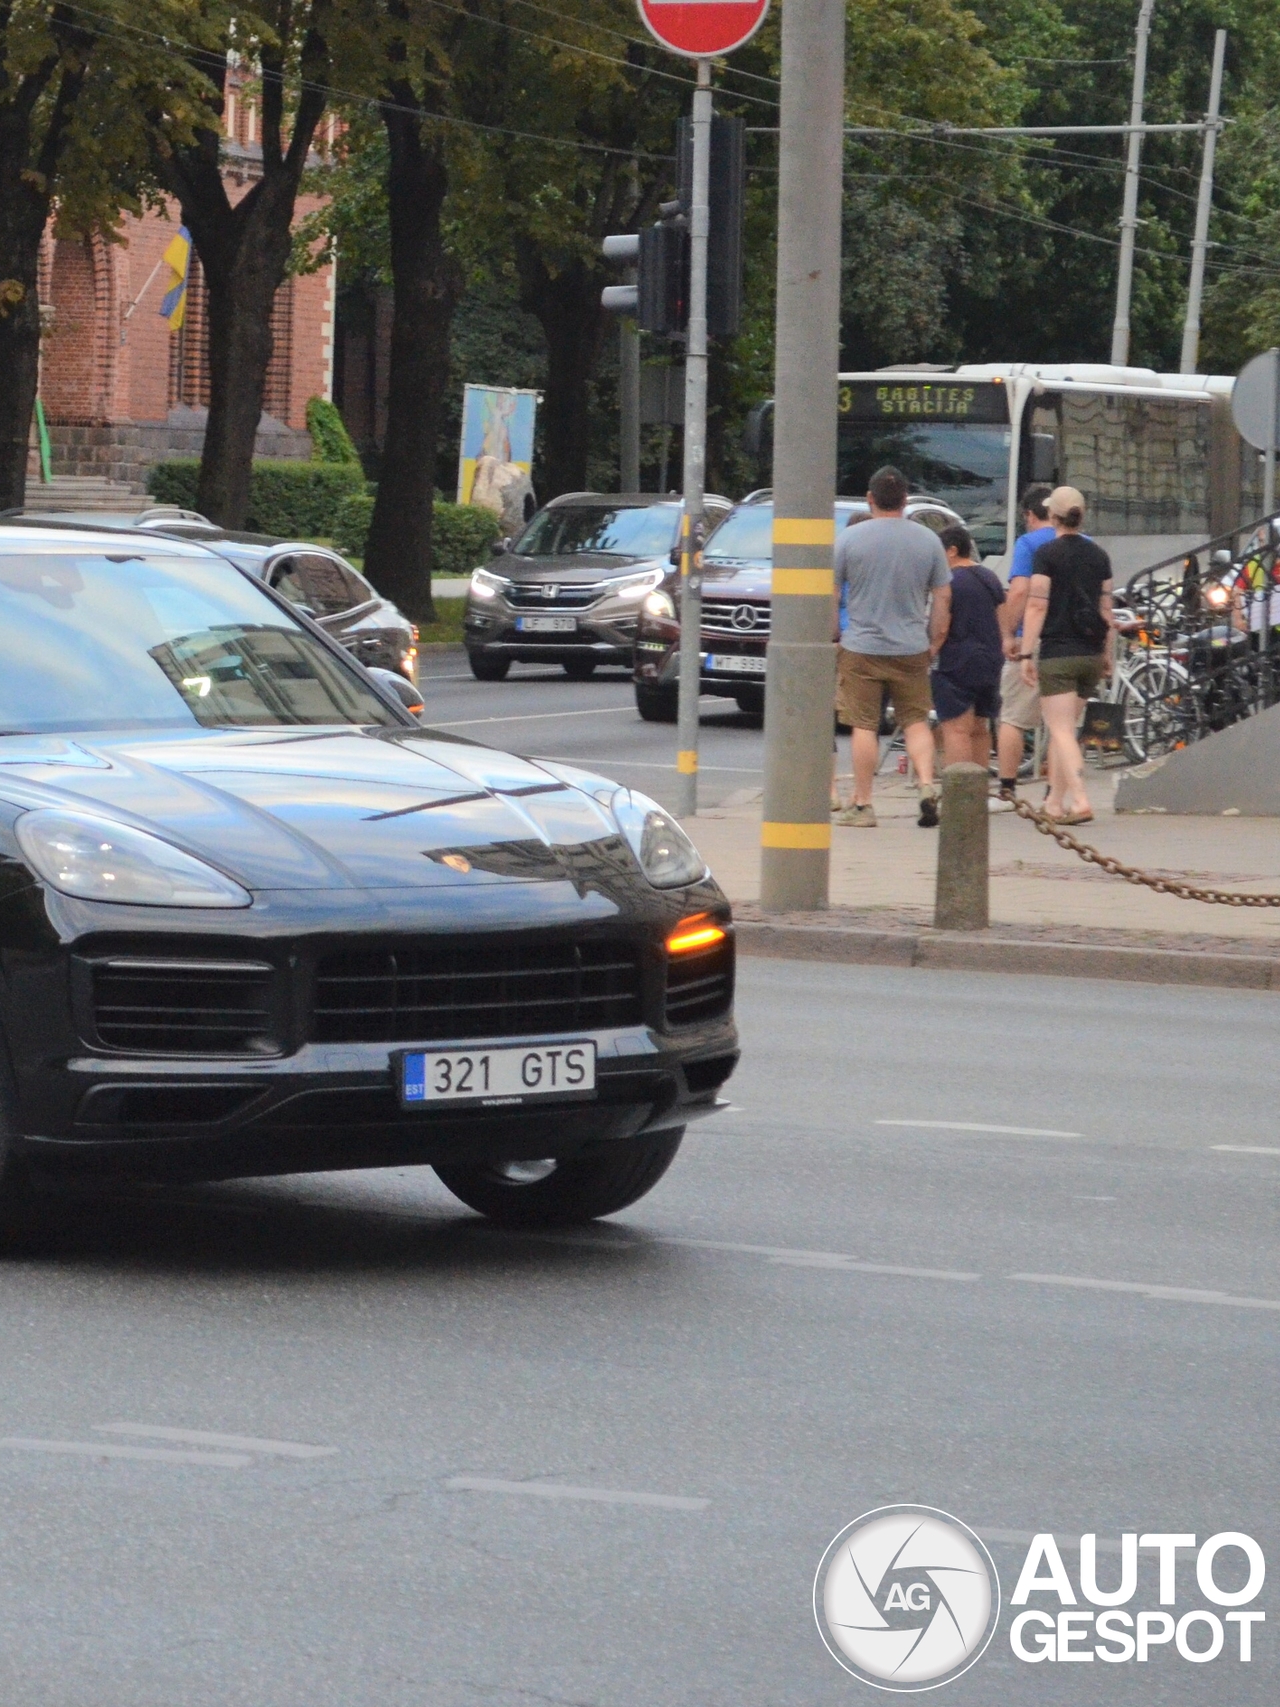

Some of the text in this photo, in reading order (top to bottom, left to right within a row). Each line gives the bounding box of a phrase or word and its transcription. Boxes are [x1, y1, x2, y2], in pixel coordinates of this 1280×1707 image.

[882, 400, 969, 413] STACIJA
[434, 1049, 586, 1093] 321 GTS
[405, 1083, 425, 1096] EST
